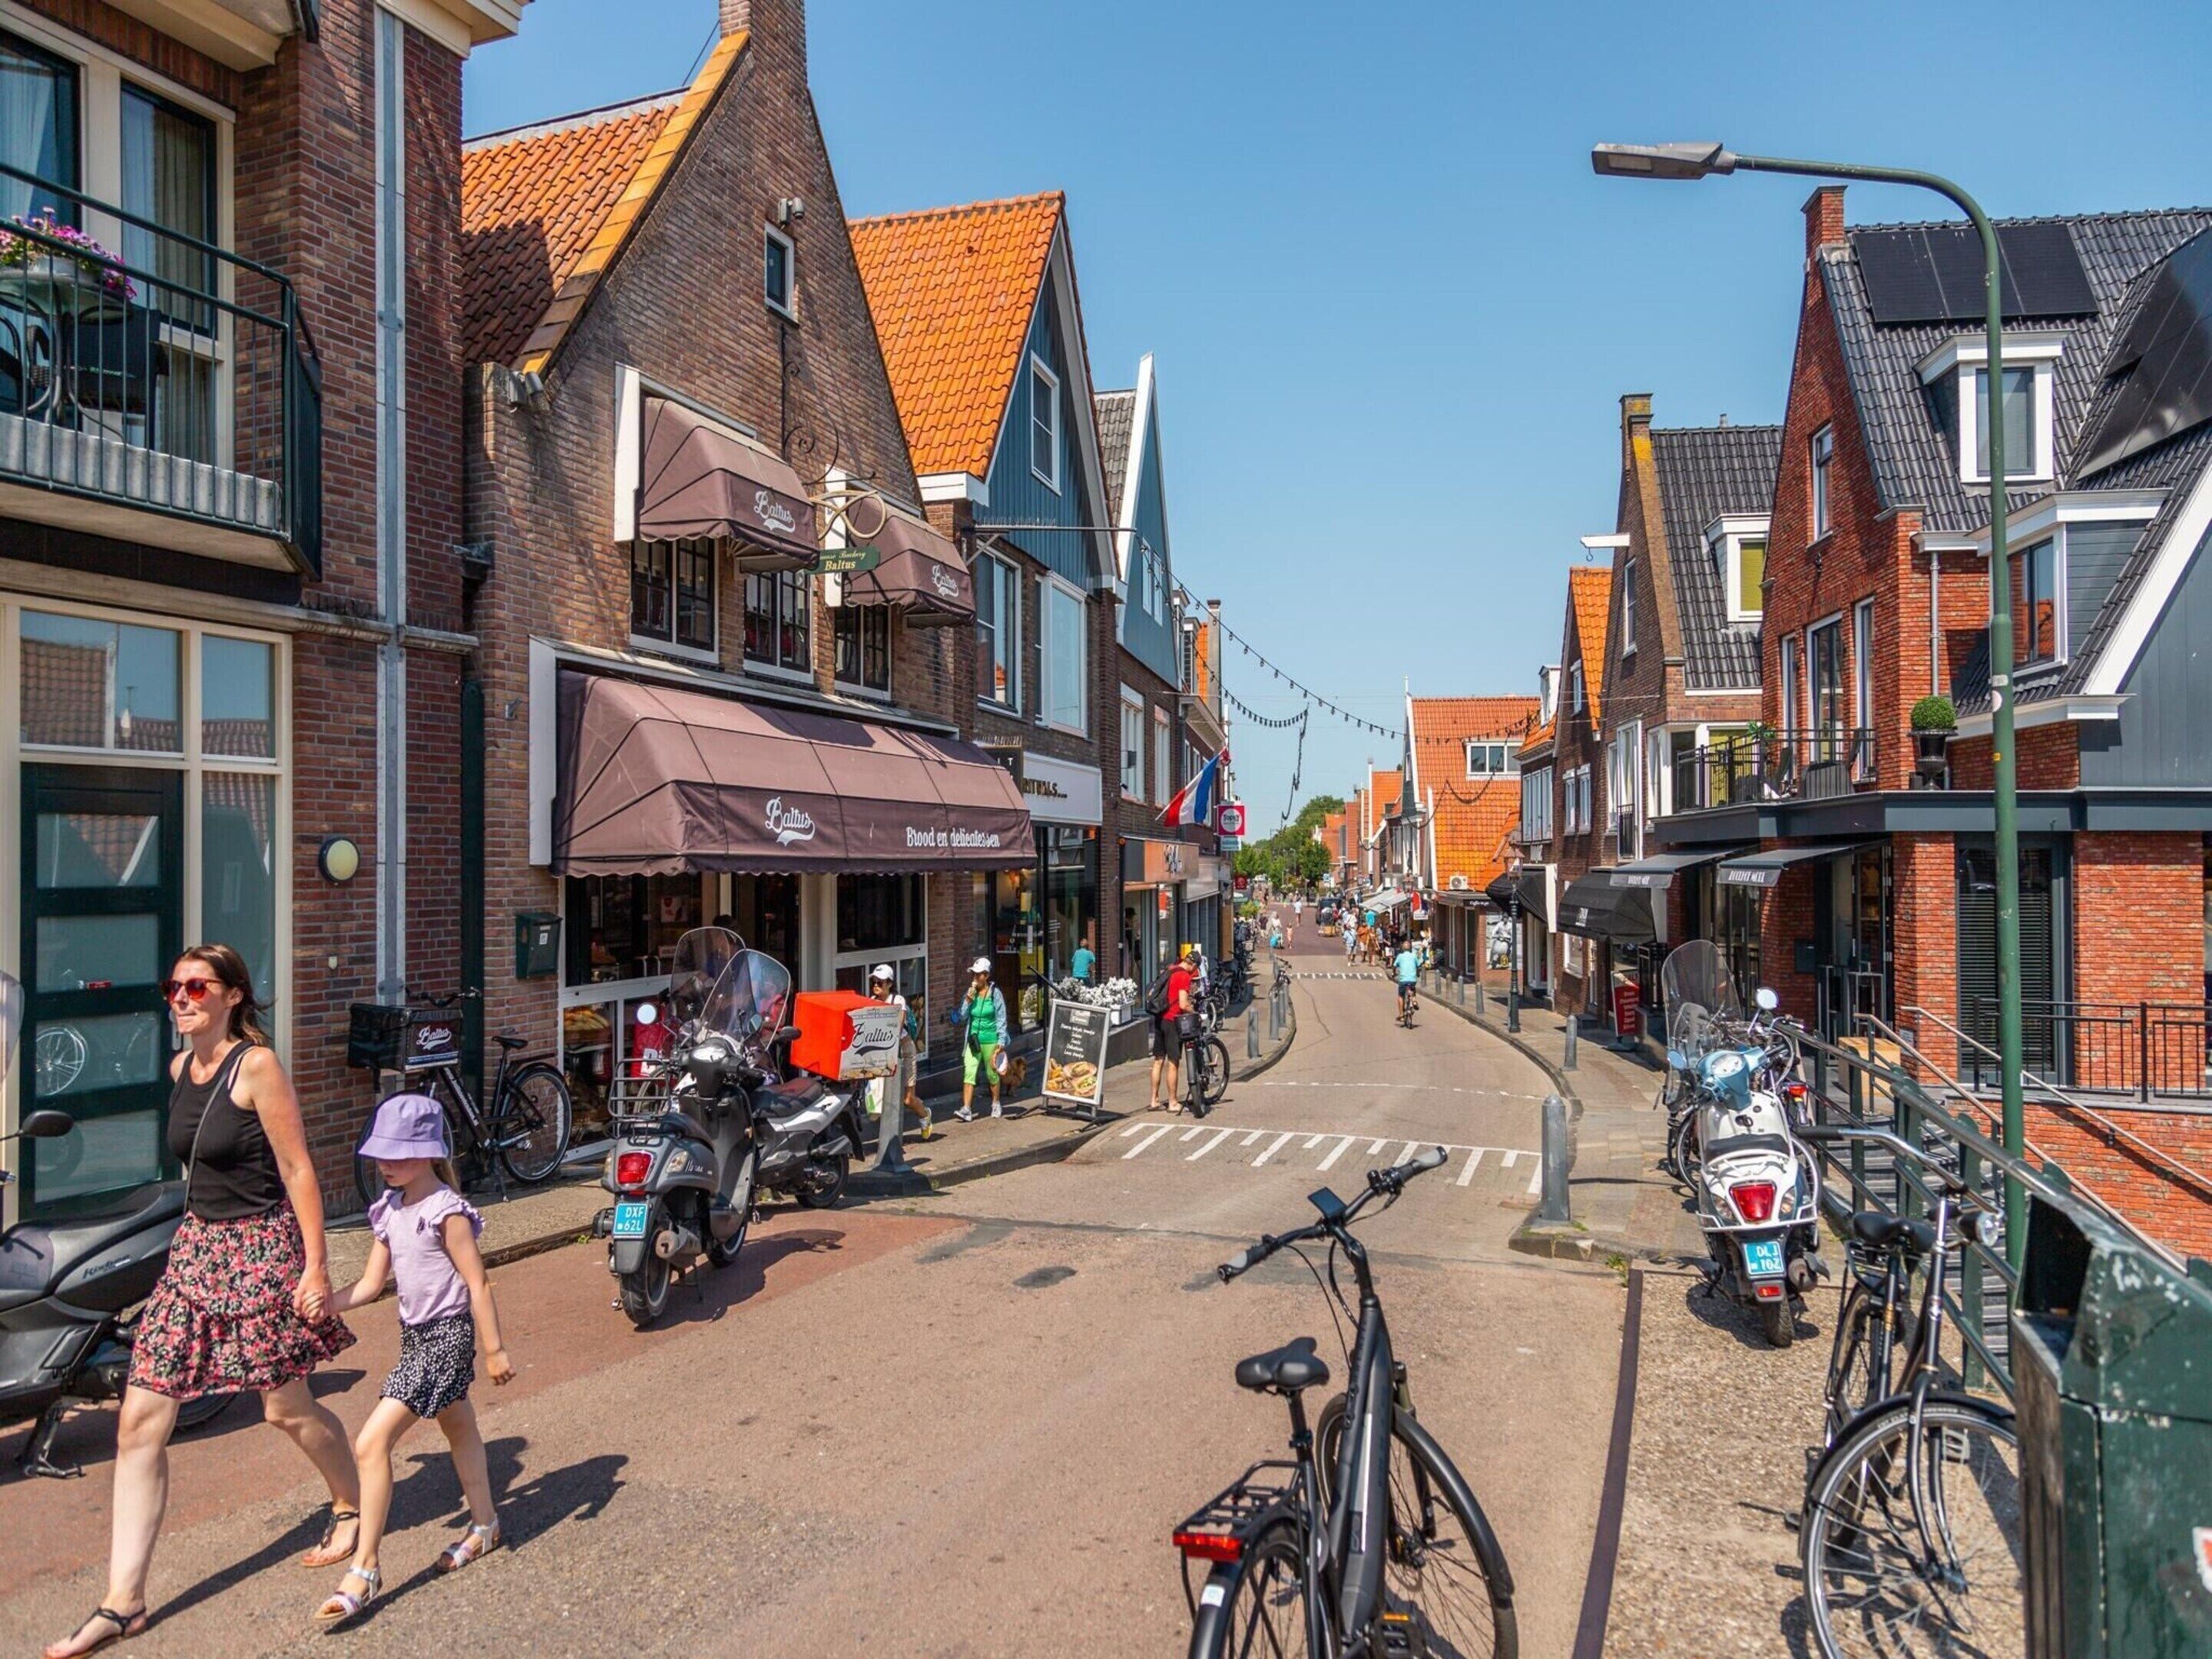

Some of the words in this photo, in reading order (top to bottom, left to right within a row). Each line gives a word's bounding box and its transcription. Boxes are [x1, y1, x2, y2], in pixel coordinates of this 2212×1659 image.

[753, 491, 796, 528] Baltus
[824, 560, 856, 571] Baltus
[765, 796, 815, 842] Baltus
[906, 826, 935, 847] Brood
[937, 832, 949, 847] en
[950, 827, 1000, 848] delicatessen
[625, 1207, 644, 1218] DXF
[624, 1219, 642, 1231] 62L
[1757, 1246, 1779, 1257] DLJ
